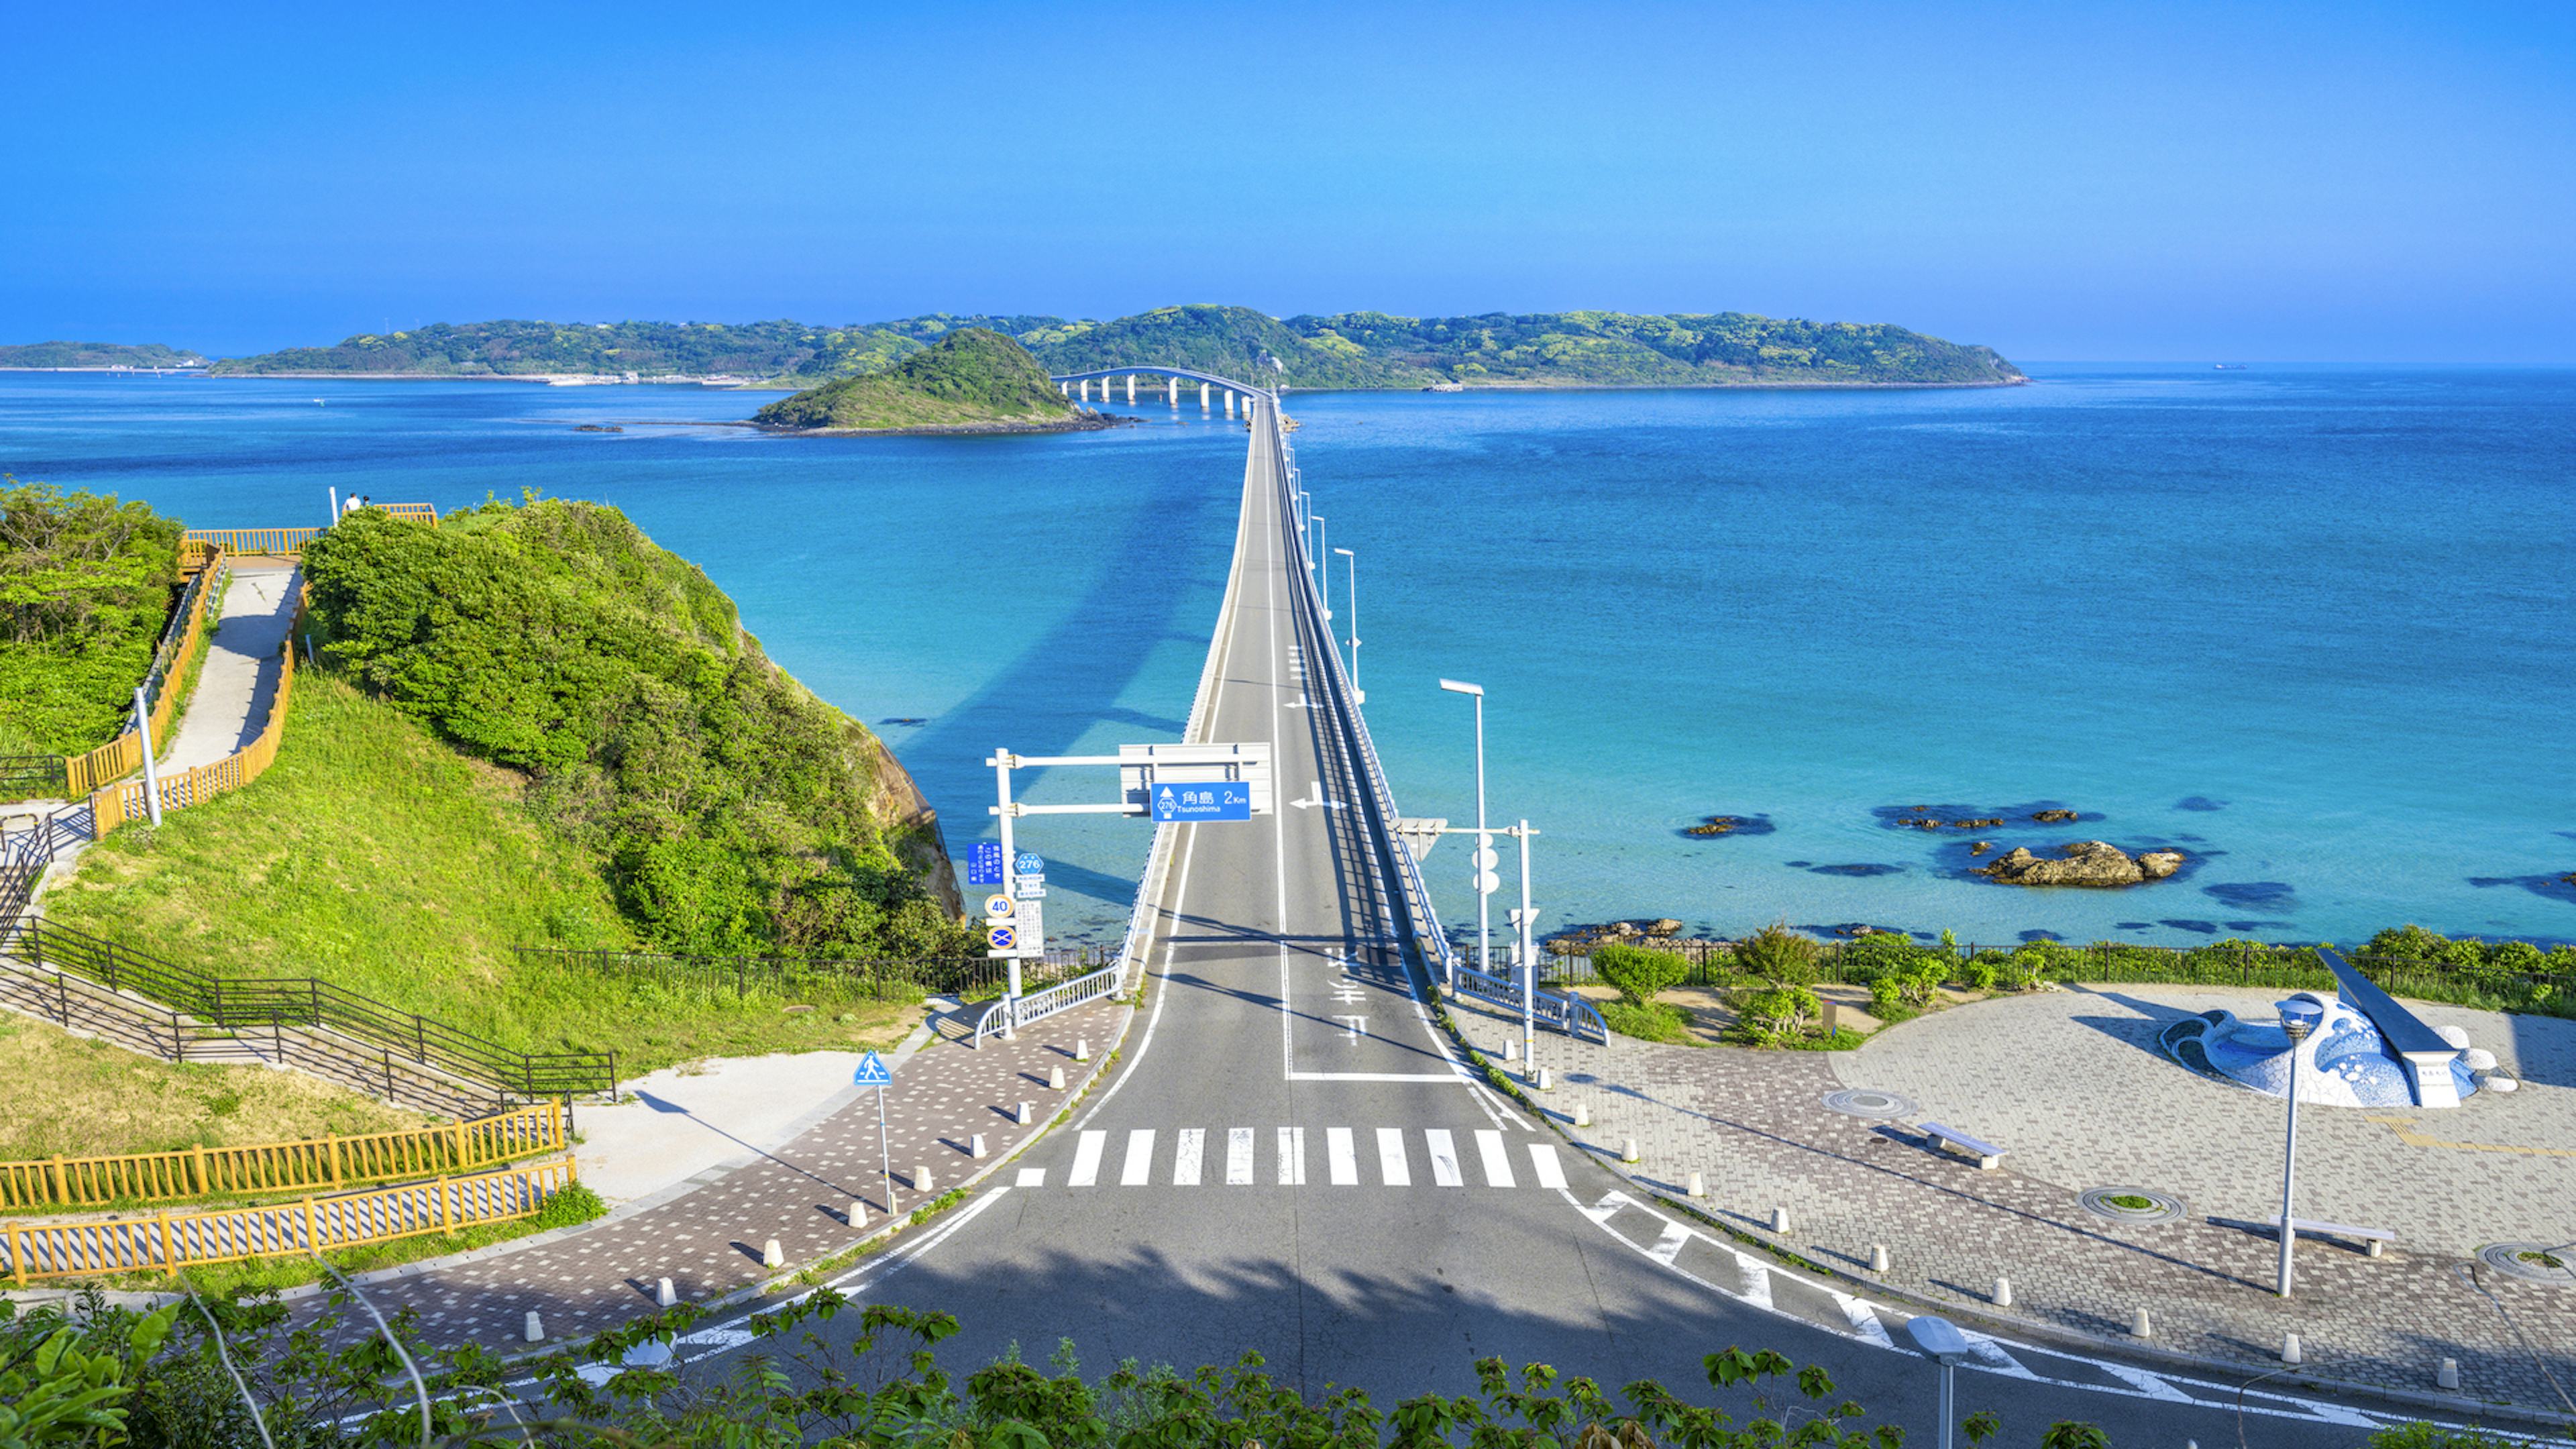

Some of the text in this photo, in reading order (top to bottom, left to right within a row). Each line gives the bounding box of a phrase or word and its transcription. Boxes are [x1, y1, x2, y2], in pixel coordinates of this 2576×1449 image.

[1183, 791, 1214, 804] 角島
[1177, 805, 1221, 813] Tsunoshima
[1020, 860, 1040, 869] 276
[992, 901, 1008, 912] 40
[1324, 947, 1369, 1046] 止まれ
